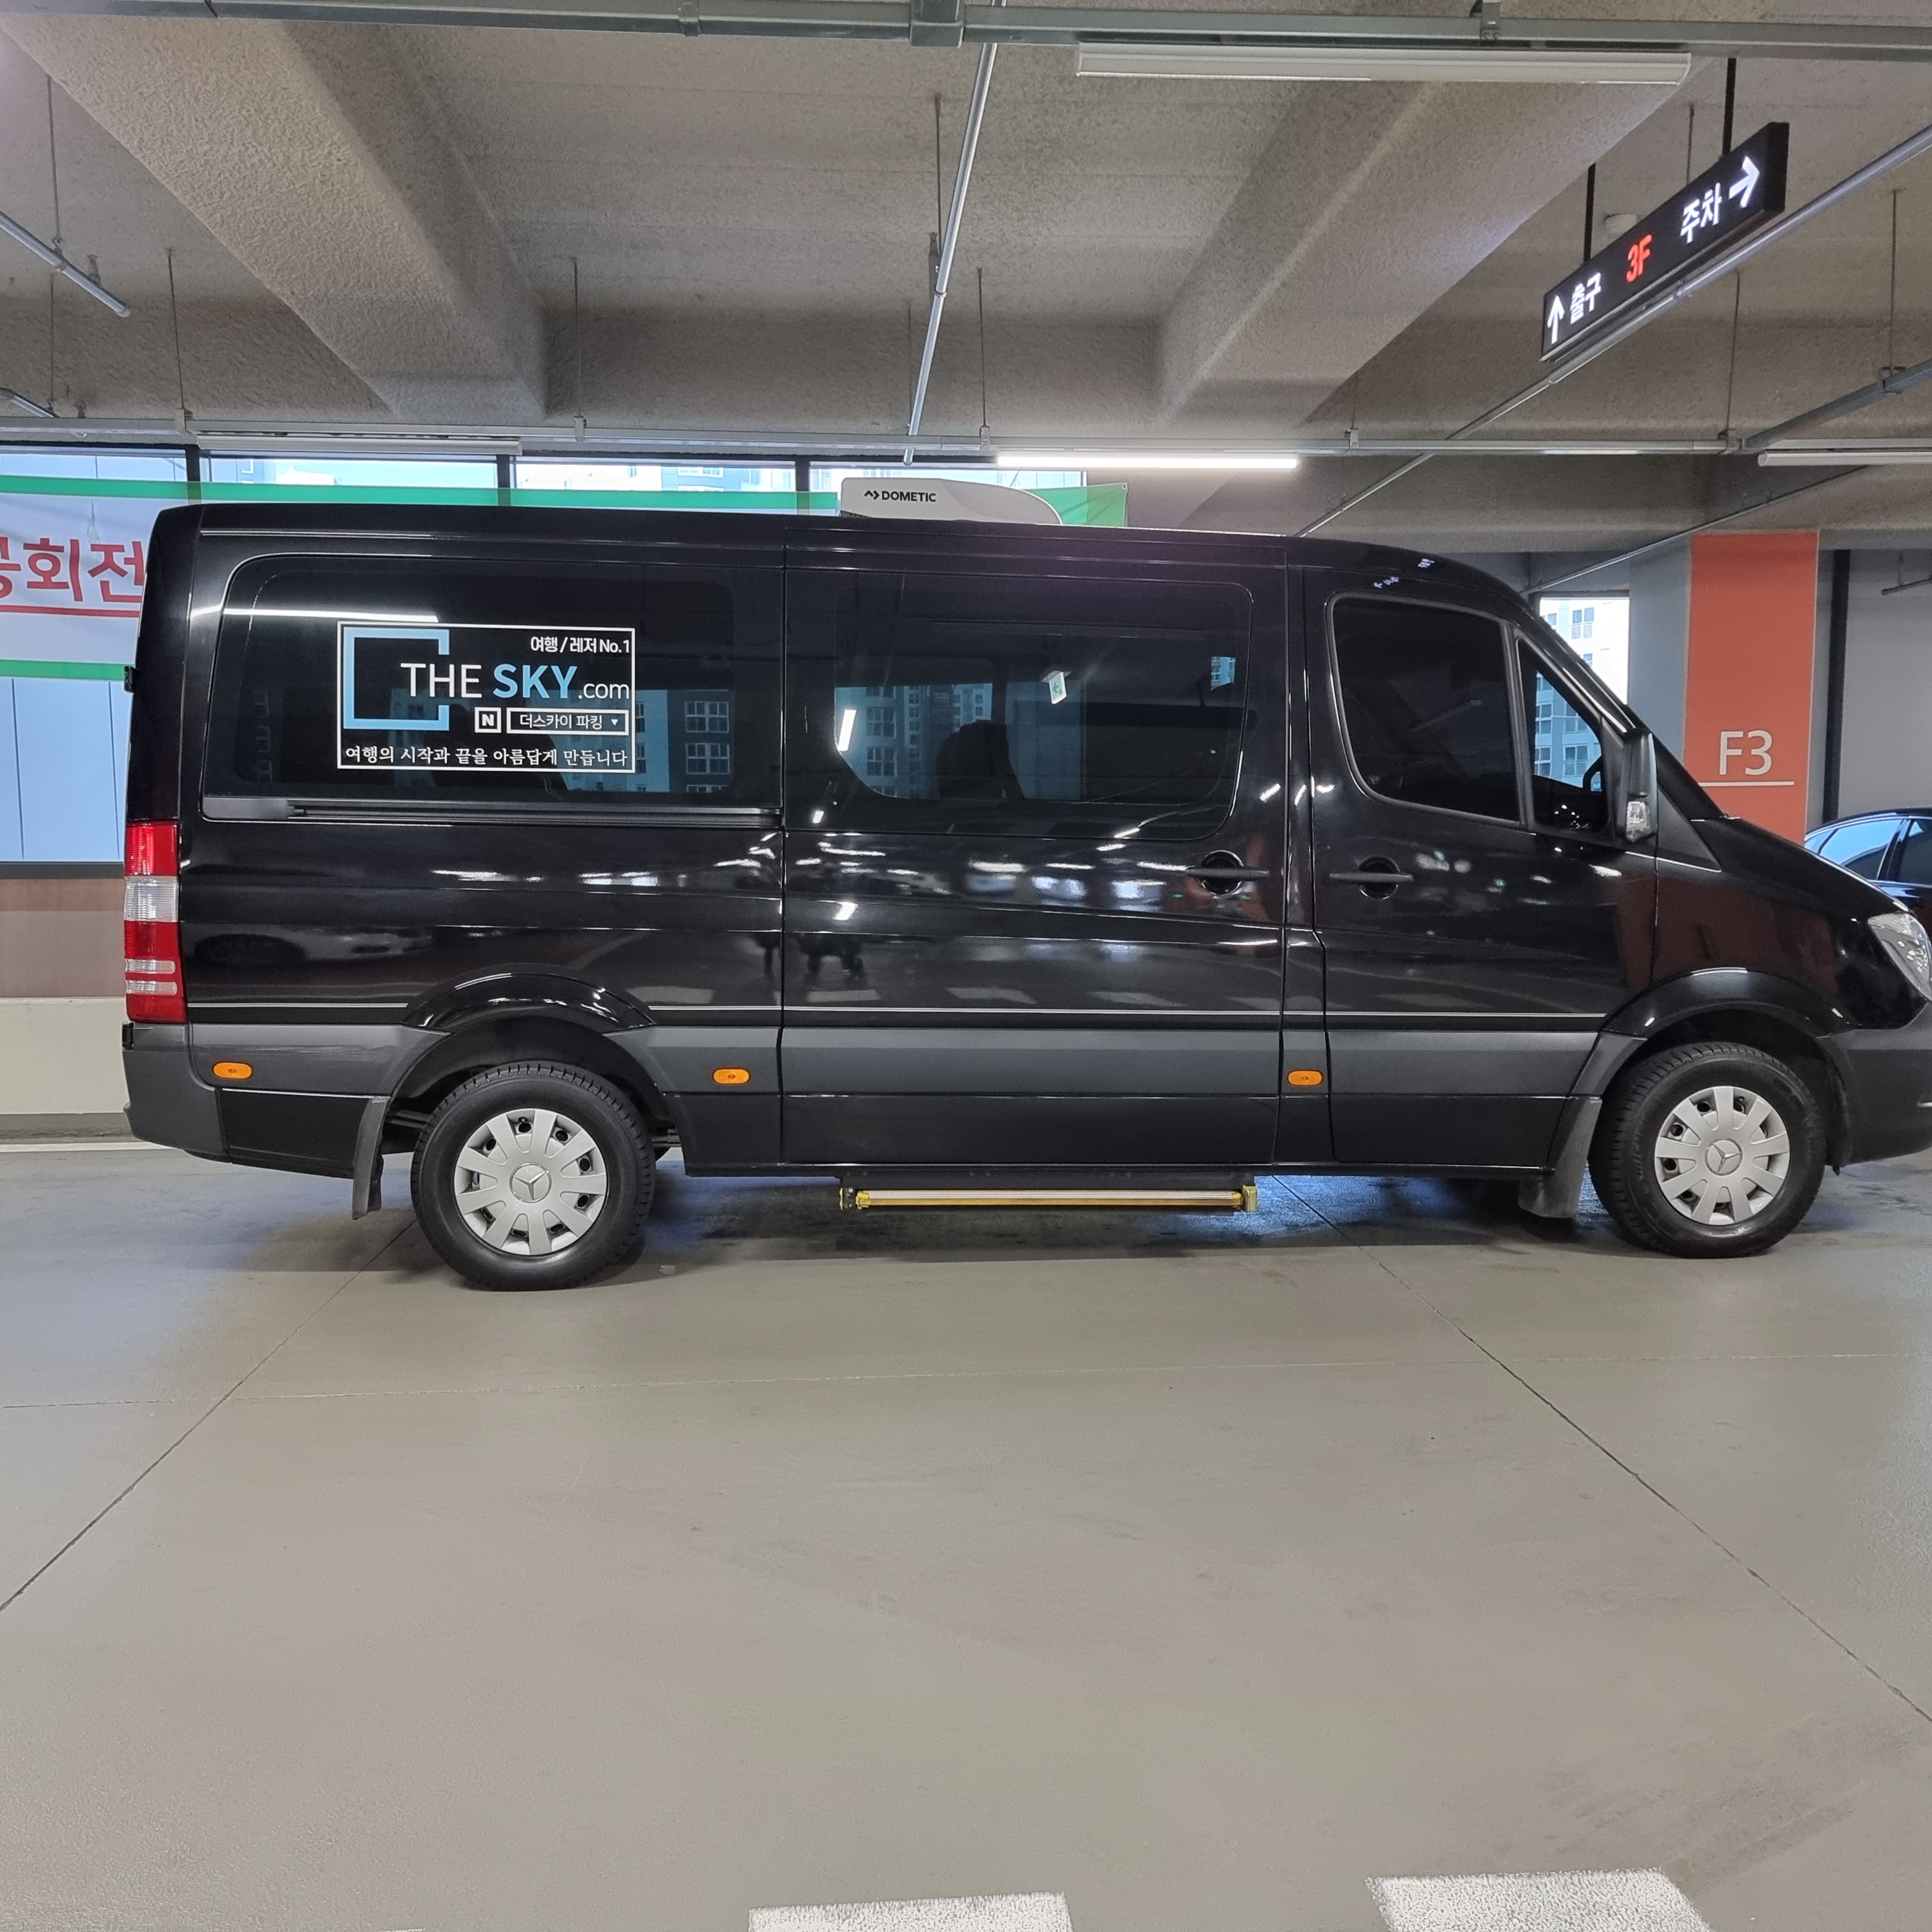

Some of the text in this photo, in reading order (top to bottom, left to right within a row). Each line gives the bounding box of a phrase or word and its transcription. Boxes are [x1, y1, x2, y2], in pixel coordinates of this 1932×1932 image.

[1570, 182, 1723, 325] 출구 3F 주차
[881, 490, 937, 502] DOMETIC
[400, 663, 482, 698] THE
[482, 714, 495, 726] N
[520, 714, 602, 730] 더스카이 파킹
[345, 745, 628, 767] 여행의 시작과 끝을 아름답게 만듭니다
[1719, 730, 1773, 776] F3
